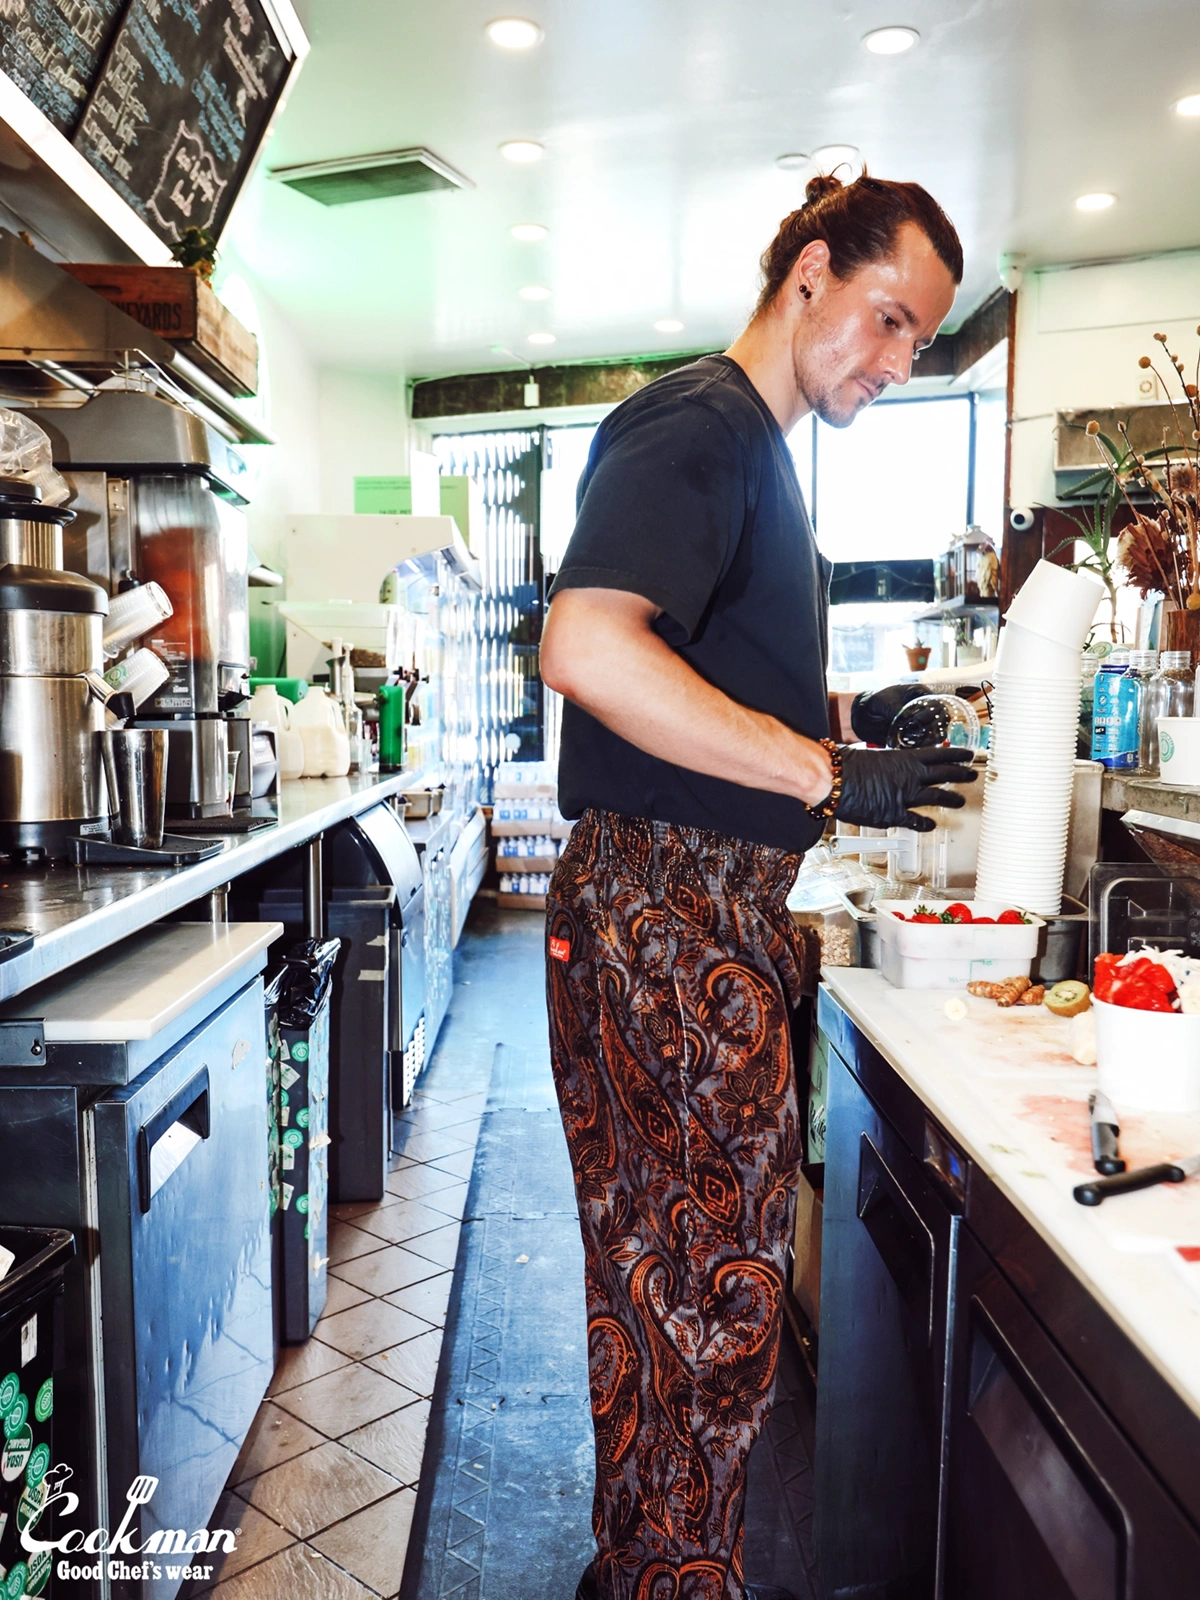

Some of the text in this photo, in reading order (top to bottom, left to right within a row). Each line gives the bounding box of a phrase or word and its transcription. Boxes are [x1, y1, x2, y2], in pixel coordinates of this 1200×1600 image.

[6, 1454, 24, 1468] USDA
[28, 1487, 44, 1506] USDA
[29, 1550, 47, 1575] USDA
